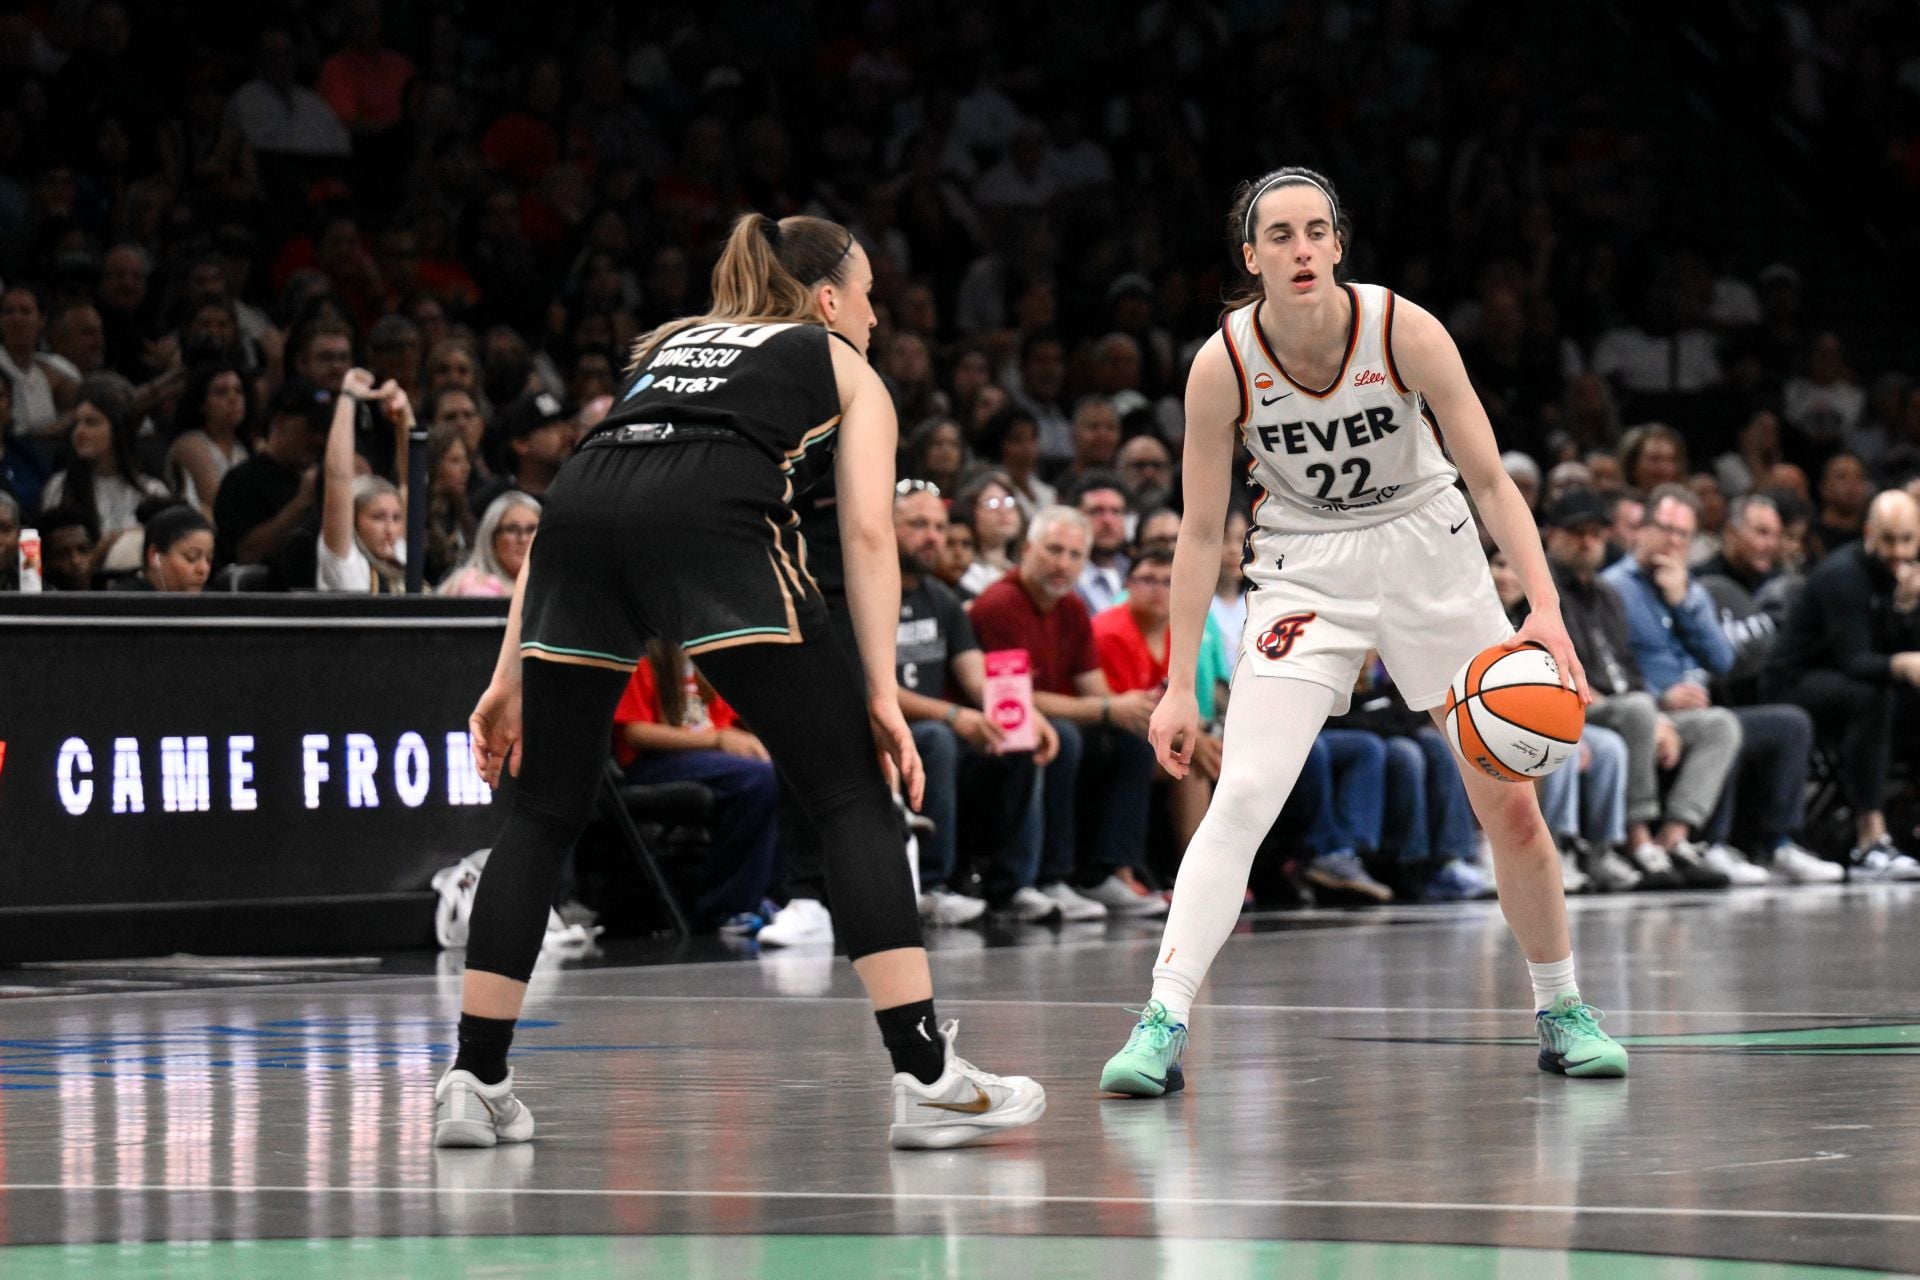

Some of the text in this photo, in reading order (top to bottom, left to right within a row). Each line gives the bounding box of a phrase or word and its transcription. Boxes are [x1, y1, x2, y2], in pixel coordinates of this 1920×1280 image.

[652, 375, 728, 394] AT&T
[1354, 370, 1387, 387] Lilly
[1257, 406, 1401, 455] FEVER
[1306, 457, 1377, 503] 22
[57, 736, 258, 815] CAME
[302, 731, 493, 808] FROM
